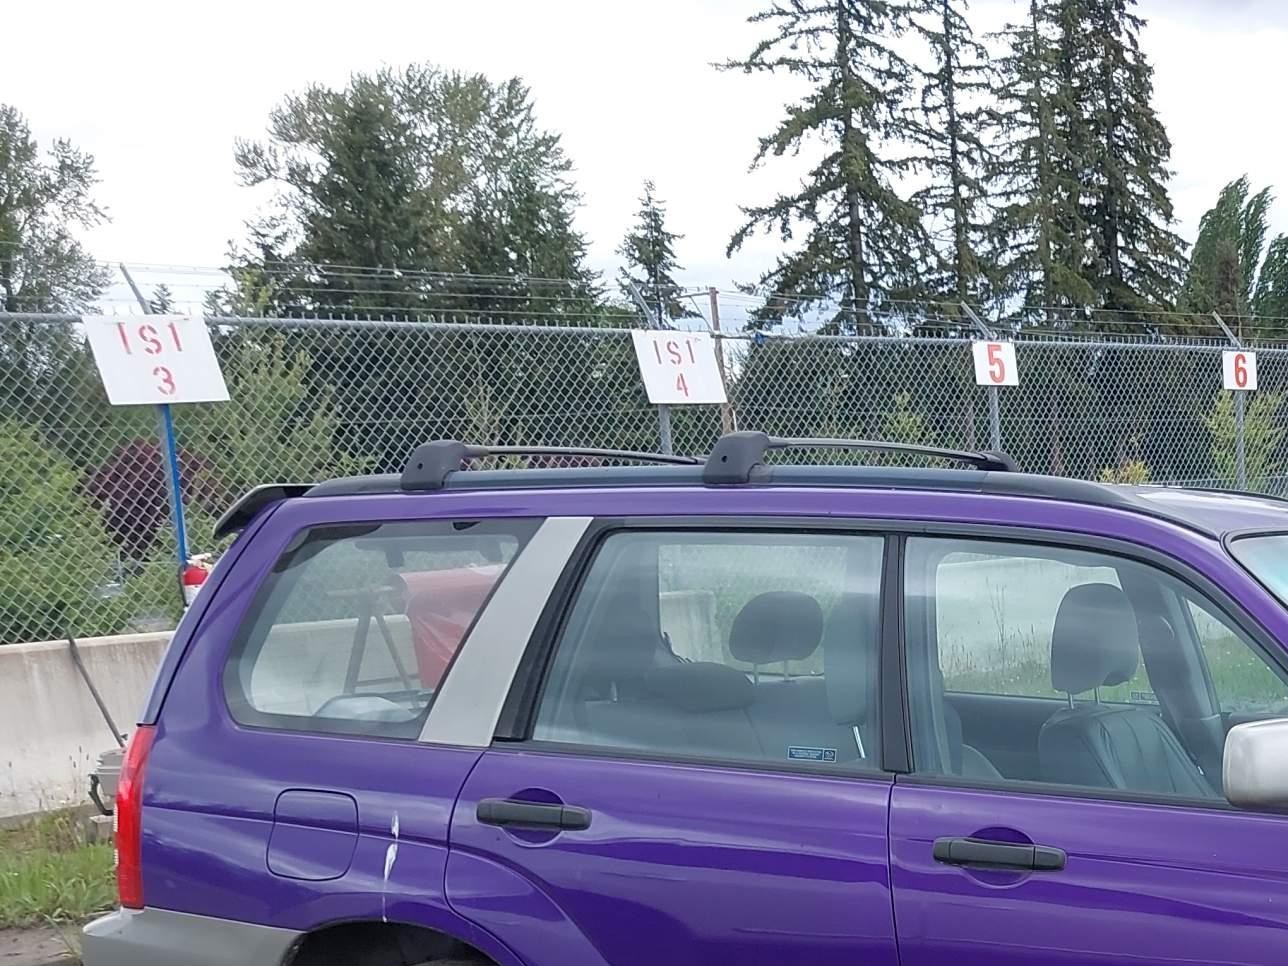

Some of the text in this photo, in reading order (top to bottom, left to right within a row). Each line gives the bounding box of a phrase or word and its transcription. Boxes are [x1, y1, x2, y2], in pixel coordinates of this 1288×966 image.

[117, 322, 182, 355] ISI
[653, 339, 695, 365] ISI
[987, 344, 1006, 384] 5
[1234, 353, 1248, 388] 6
[152, 366, 177, 396] 3
[676, 373, 689, 397] 4
